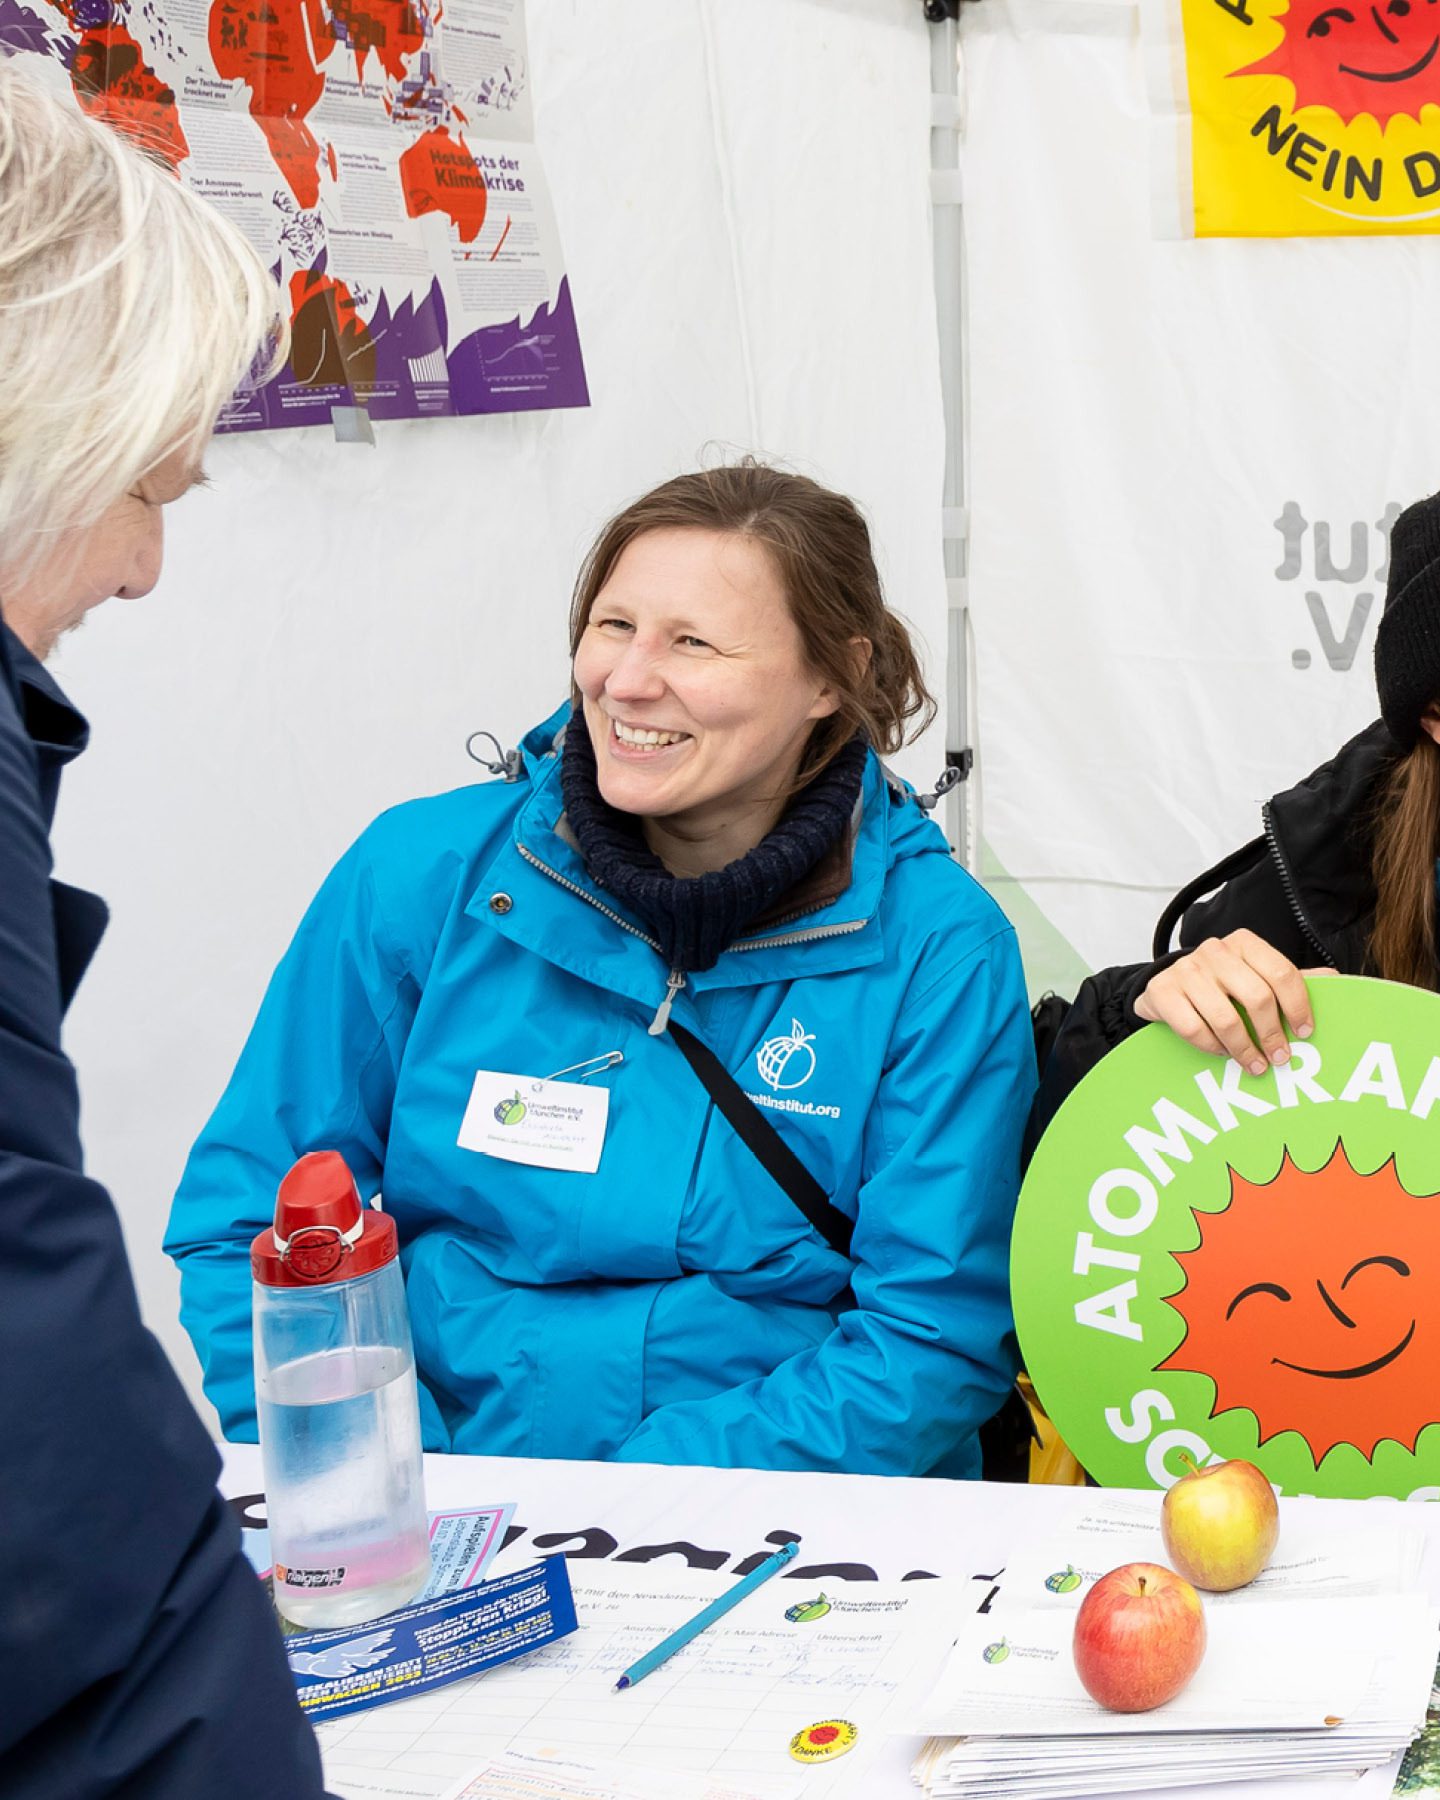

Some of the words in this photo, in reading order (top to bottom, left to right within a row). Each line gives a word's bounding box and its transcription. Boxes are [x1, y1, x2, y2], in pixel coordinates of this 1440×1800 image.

[430, 149, 496, 170] Hotspots
[499, 153, 519, 170] der
[1250, 104, 1382, 201] NEIN
[435, 167, 525, 192] Klimakrise
[419, 1622, 471, 1648] Stoppt
[471, 1612, 501, 1628] den
[503, 1590, 548, 1614] Krieg!
[297, 1668, 384, 1696] ESKALIEREN
[385, 1657, 422, 1674] STATT
[385, 1670, 422, 1686] 2023
